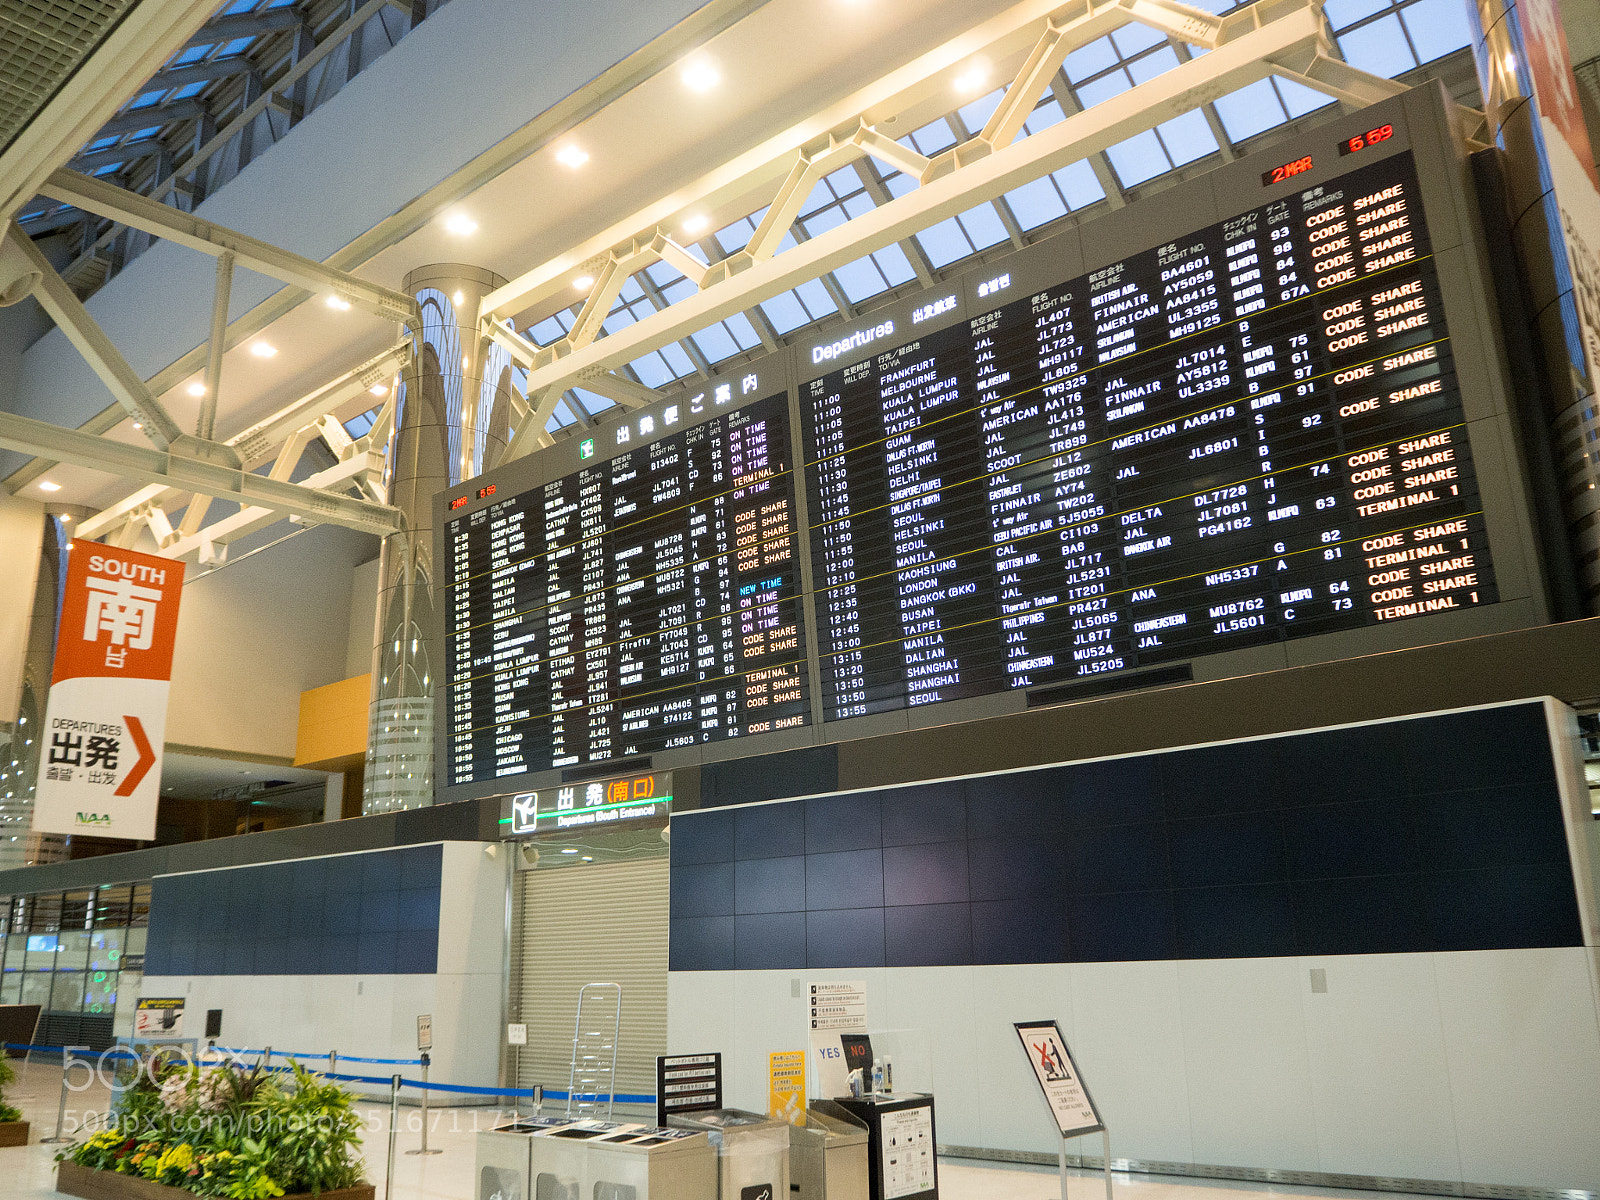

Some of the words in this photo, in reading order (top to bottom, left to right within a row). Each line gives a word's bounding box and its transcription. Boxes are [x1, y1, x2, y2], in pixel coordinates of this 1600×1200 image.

[1303, 190, 1343, 212] REMARKS
[1305, 205, 1345, 227] CODE
[1353, 184, 1403, 210] SHARE
[1268, 210, 1290, 225] GATE
[1271, 227, 1289, 240] 93
[1159, 249, 1187, 266] FLIGHT
[1277, 257, 1294, 270] 84
[1161, 256, 1209, 281] BA4601
[1317, 267, 1356, 288] CODE
[1365, 247, 1416, 272] SHARE
[1091, 275, 1120, 292] AIRLINE
[1164, 270, 1214, 295] AY5059
[1166, 284, 1216, 309] AA8415
[1281, 284, 1310, 301] 67A
[1032, 297, 1058, 314] FLIGHT
[1168, 299, 1218, 324] UL3355
[1035, 308, 1070, 327] JL407
[1095, 305, 1159, 335] AMERICAN
[1170, 314, 1221, 339] MH9125
[972, 321, 999, 337] AIRLINE
[1036, 322, 1073, 341] JL773
[813, 320, 894, 363] Departures
[975, 338, 994, 350] JAL
[1039, 335, 1075, 354] JL723
[1289, 334, 1308, 347] 75
[1039, 346, 1083, 369] MH9117
[1176, 345, 1225, 369] JL7014
[879, 357, 935, 385] FRANKFURT
[1042, 363, 1078, 382] JL805
[1176, 360, 1228, 384] AY5812
[881, 371, 936, 398] MELBOURNE
[883, 393, 913, 410] KUALA
[919, 377, 958, 397] LUMPUR
[1042, 375, 1087, 396] TW9325
[1177, 374, 1230, 398] UL3339
[814, 394, 840, 409] 11:00
[1045, 392, 1081, 411] AA176
[1339, 397, 1380, 417] CODE
[1389, 380, 1441, 403] SHARE
[983, 405, 1038, 431] AMERICAN
[1047, 406, 1084, 424] JL413
[1184, 406, 1235, 429] AA8478
[730, 431, 740, 441] ON
[745, 421, 765, 435] TIME
[885, 416, 921, 435] TAIPEI
[1049, 420, 1085, 439] JL749
[711, 438, 720, 448] 75
[886, 434, 911, 449] GUAM
[1050, 435, 1087, 453] TR899
[1189, 438, 1238, 459] JL6801
[712, 450, 721, 459] 92
[818, 455, 845, 471] 11:25
[987, 454, 1021, 473] SCOOT
[1053, 452, 1081, 467] JL12
[888, 453, 937, 475] HELSINKI
[1053, 464, 1091, 482] ZE602
[1310, 464, 1330, 476] 74
[733, 470, 774, 487] TERMINAL
[780, 463, 783, 471] 1
[890, 471, 920, 488] DELHI
[653, 477, 680, 493] JL7041
[1055, 481, 1085, 497] AY74
[581, 494, 601, 507] XT402
[992, 493, 1041, 514] FINNAIR
[1057, 493, 1094, 510] TW202
[1194, 485, 1247, 506] DL7728
[1357, 490, 1440, 516] TERMINAL
[1450, 485, 1458, 495] 1
[735, 510, 755, 523] CODE
[761, 500, 787, 514] SHARE
[894, 513, 924, 527] SEOUL
[1059, 506, 1105, 526] 5J5055
[1121, 507, 1162, 525] DELTA
[1198, 501, 1247, 522] JL7081
[546, 516, 570, 530] CATHAY
[582, 524, 605, 538] JL5201
[1059, 523, 1099, 540] CI103
[1198, 517, 1252, 538] PG4162
[583, 548, 602, 560] JL741
[897, 551, 935, 567] MANILA
[996, 544, 1017, 556] CAL
[88, 555, 165, 584] SOUTH
[1065, 553, 1102, 569] JL717
[899, 560, 957, 581] KAOHSIUNG
[1067, 566, 1110, 584] JL5231
[1205, 565, 1258, 586] NH5337
[740, 584, 756, 595] NEW
[760, 577, 782, 590] TIME
[900, 578, 938, 595] LONDON
[1069, 583, 1105, 600] IT201
[1132, 588, 1156, 602] ANA
[900, 590, 945, 608] BANGKOK
[948, 583, 976, 597] (BKK)
[1332, 598, 1352, 610] 73
[83, 576, 162, 650] 南
[659, 604, 685, 617] JL7021
[902, 607, 934, 622] BUSAN
[1069, 598, 1107, 615] PR427
[1209, 598, 1264, 617] MU8762
[1373, 597, 1459, 620] TERMINAL
[1470, 592, 1478, 602] 1
[659, 616, 685, 630] JL7091
[831, 624, 859, 637] 12:45
[1214, 615, 1264, 633] JL5601
[660, 627, 687, 641] FY7049
[620, 637, 650, 651] Firefly
[1074, 645, 1114, 660] MU524
[105, 646, 128, 668] 남
[906, 648, 945, 663] DALIAN
[587, 670, 608, 681] JL957
[834, 665, 863, 677] 13:20
[907, 659, 958, 677] SHANGHAI
[1077, 658, 1124, 675] JL5205
[588, 681, 607, 692] JL941
[837, 705, 866, 717] 13:55
[52, 718, 122, 736] DEPARTURES
[589, 727, 609, 737] JL421
[749, 722, 770, 733] CODE
[776, 716, 803, 728] SHARE
[496, 734, 522, 744] CHICAGO
[590, 739, 611, 749] JL725
[48, 732, 119, 770] 出発
[820, 1047, 840, 1059] YES
[851, 1045, 865, 1056] NO
